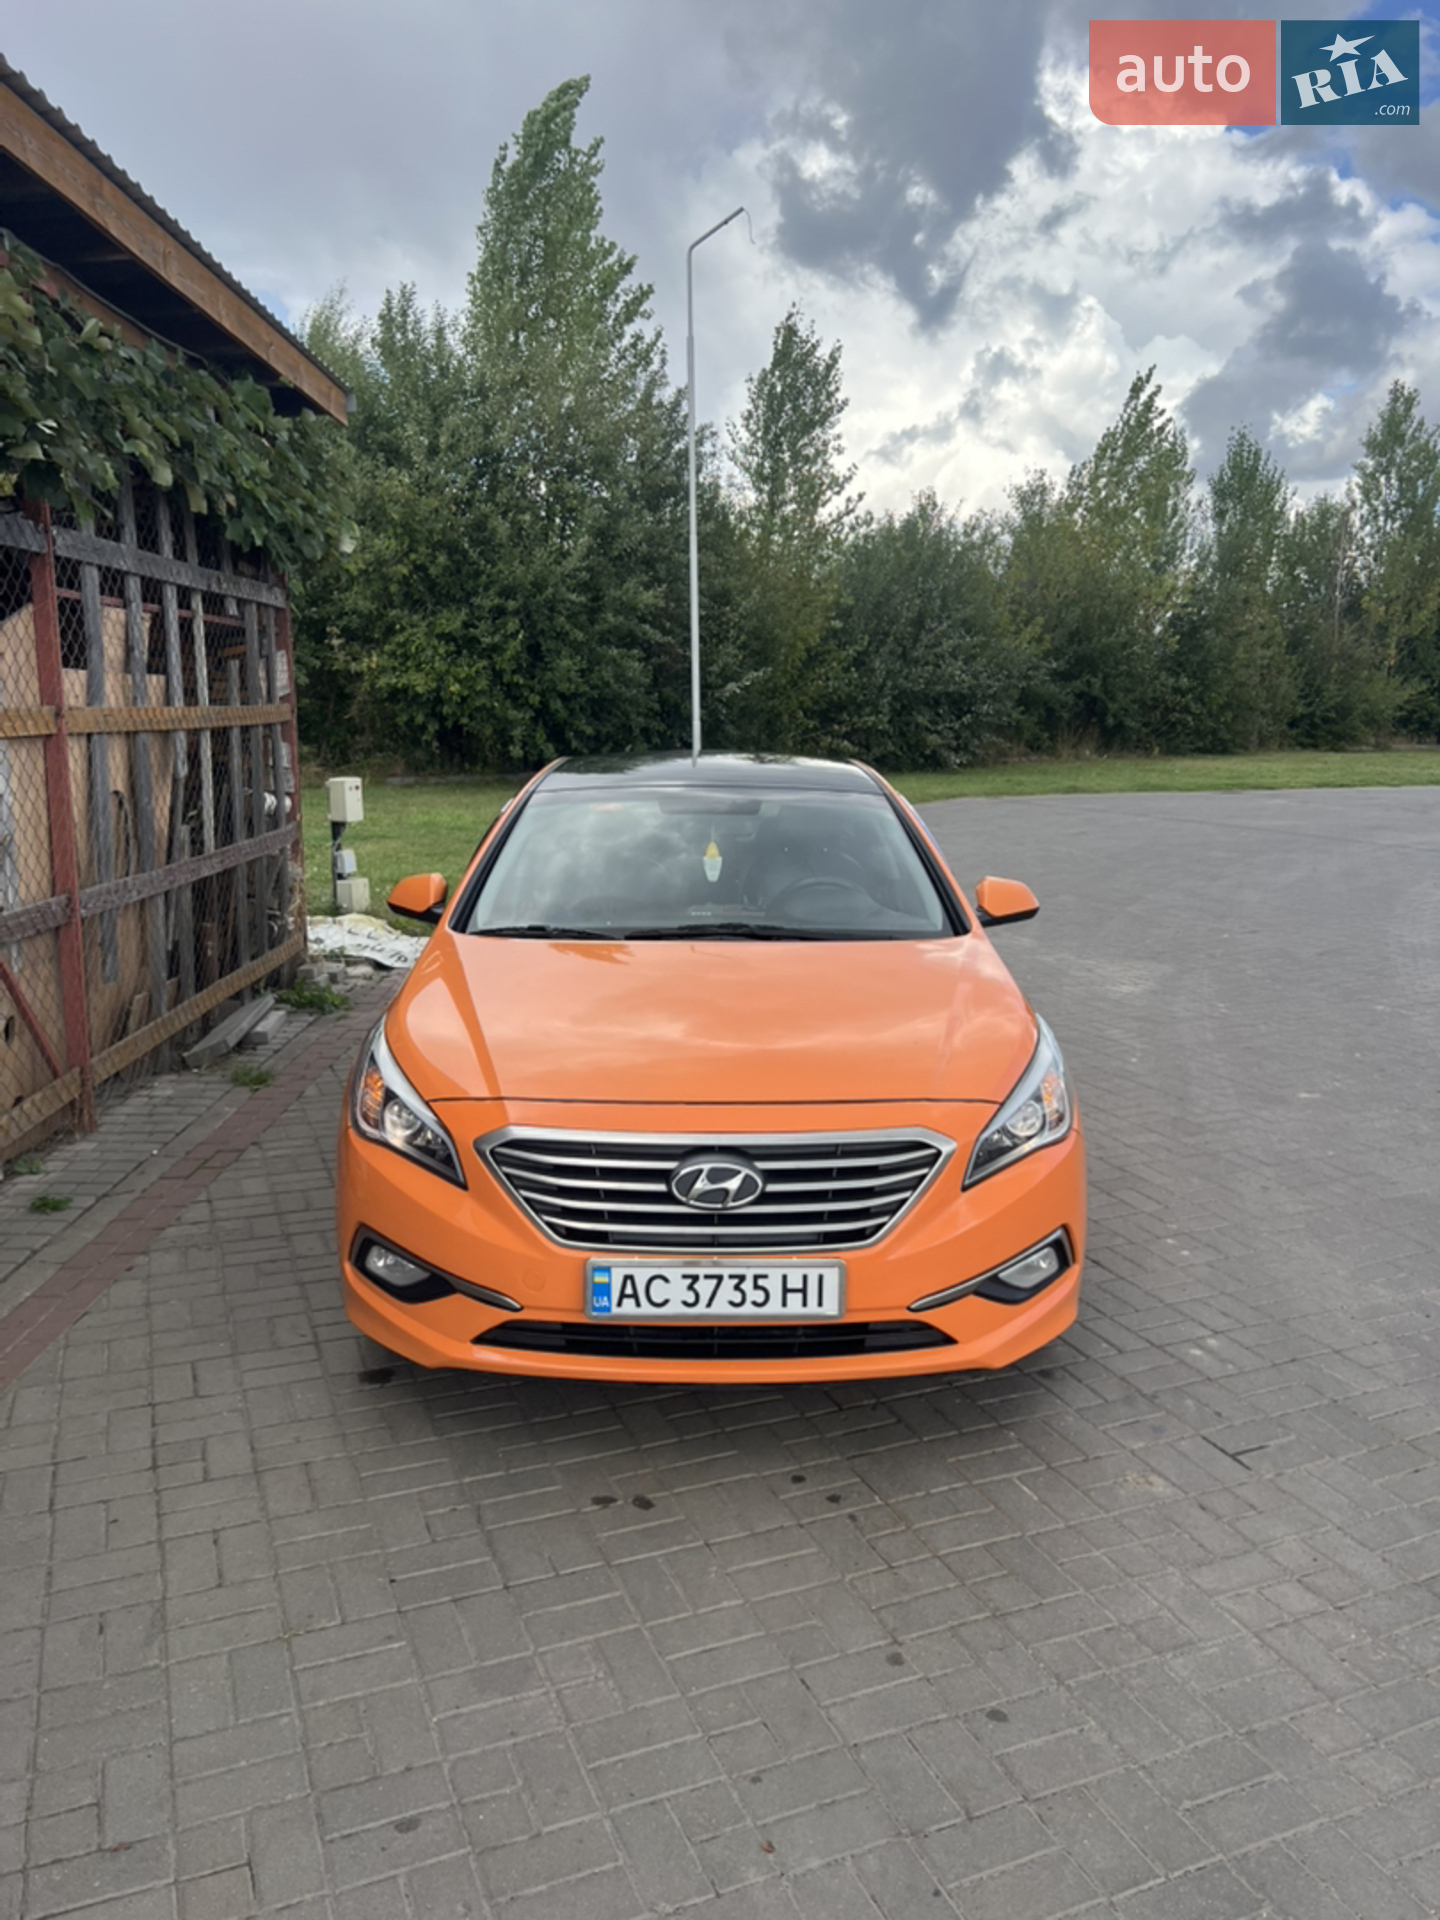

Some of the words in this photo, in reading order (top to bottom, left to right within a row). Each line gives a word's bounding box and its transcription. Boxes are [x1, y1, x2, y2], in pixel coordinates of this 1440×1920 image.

[593, 1296, 610, 1307] UA
[616, 1274, 671, 1308] AC
[681, 1274, 771, 1308] 3735
[781, 1274, 824, 1308] HI
